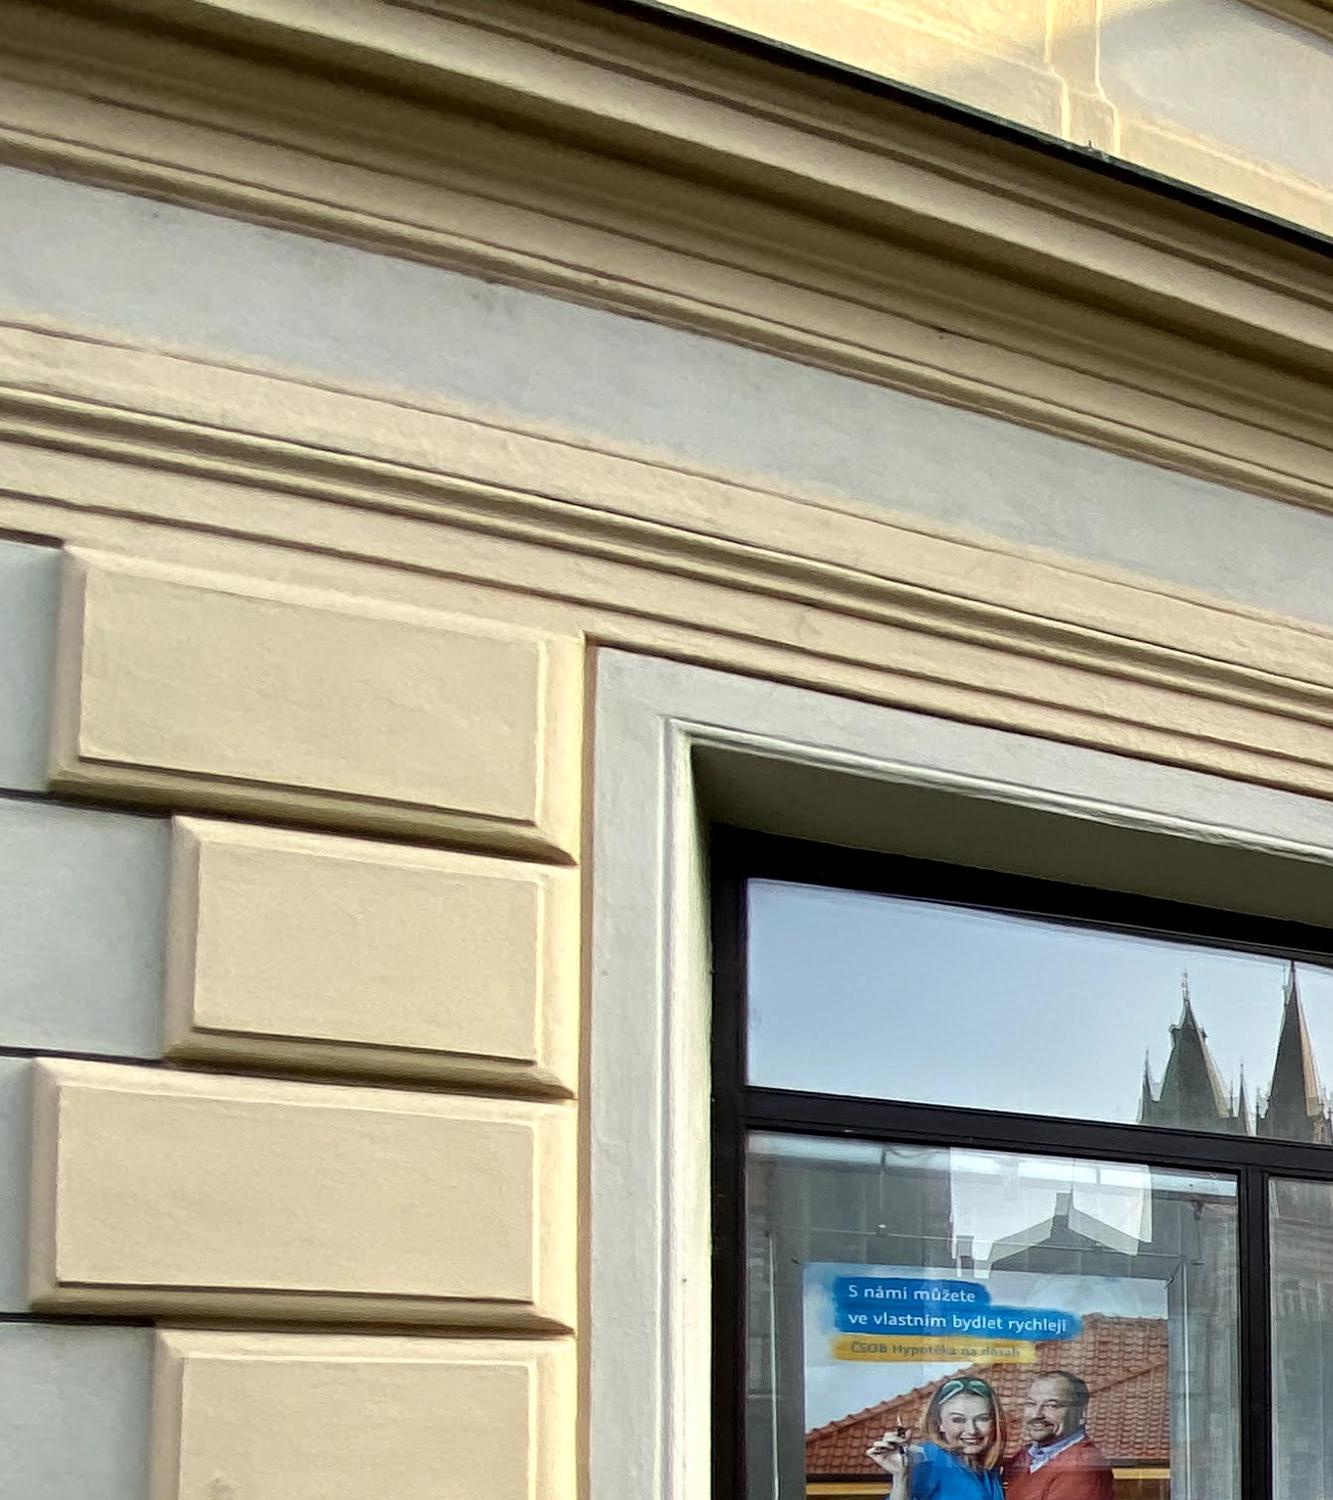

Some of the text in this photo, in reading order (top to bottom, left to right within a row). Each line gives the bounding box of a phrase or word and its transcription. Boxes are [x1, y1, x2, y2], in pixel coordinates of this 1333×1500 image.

[849, 1285, 976, 1303] S námi můžete
[848, 1312, 1067, 1332] ve vlastním bydlet rychleji
